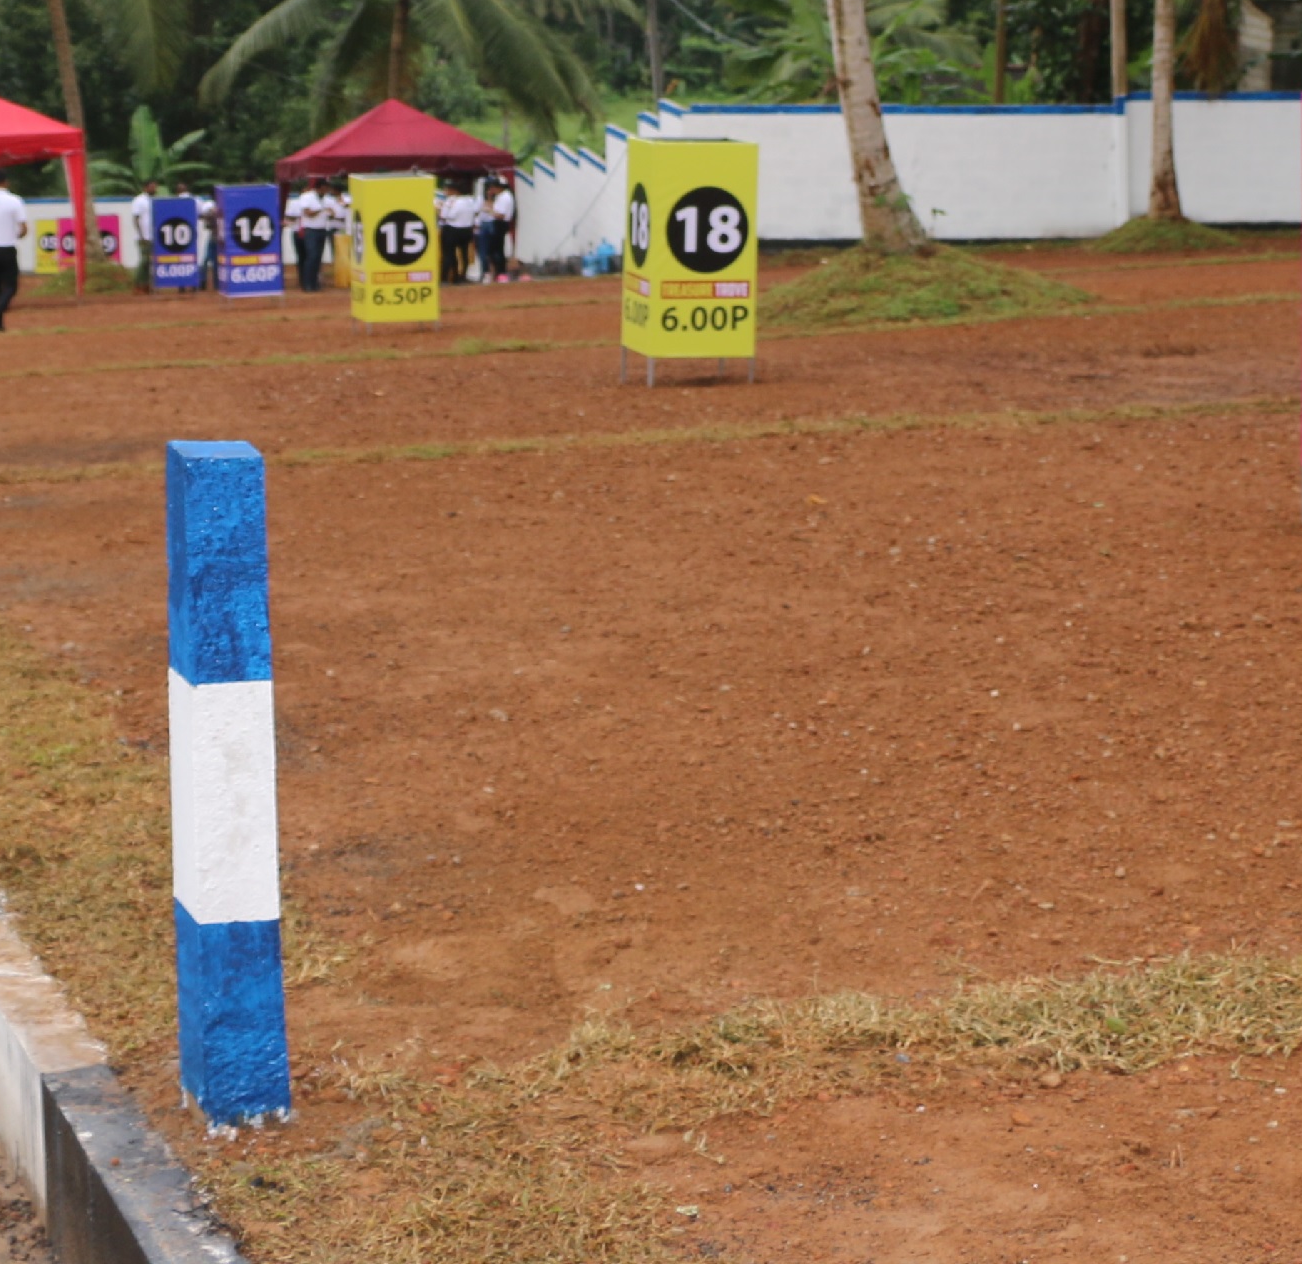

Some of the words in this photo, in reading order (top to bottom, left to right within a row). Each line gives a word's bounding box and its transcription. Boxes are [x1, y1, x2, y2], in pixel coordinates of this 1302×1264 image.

[160, 223, 192, 246] 10
[235, 216, 274, 244] 14
[380, 221, 426, 254] 15
[631, 200, 648, 250] 18
[675, 206, 742, 253] 18
[372, 286, 432, 306] 6.50P
[661, 305, 749, 332] 6.00P
